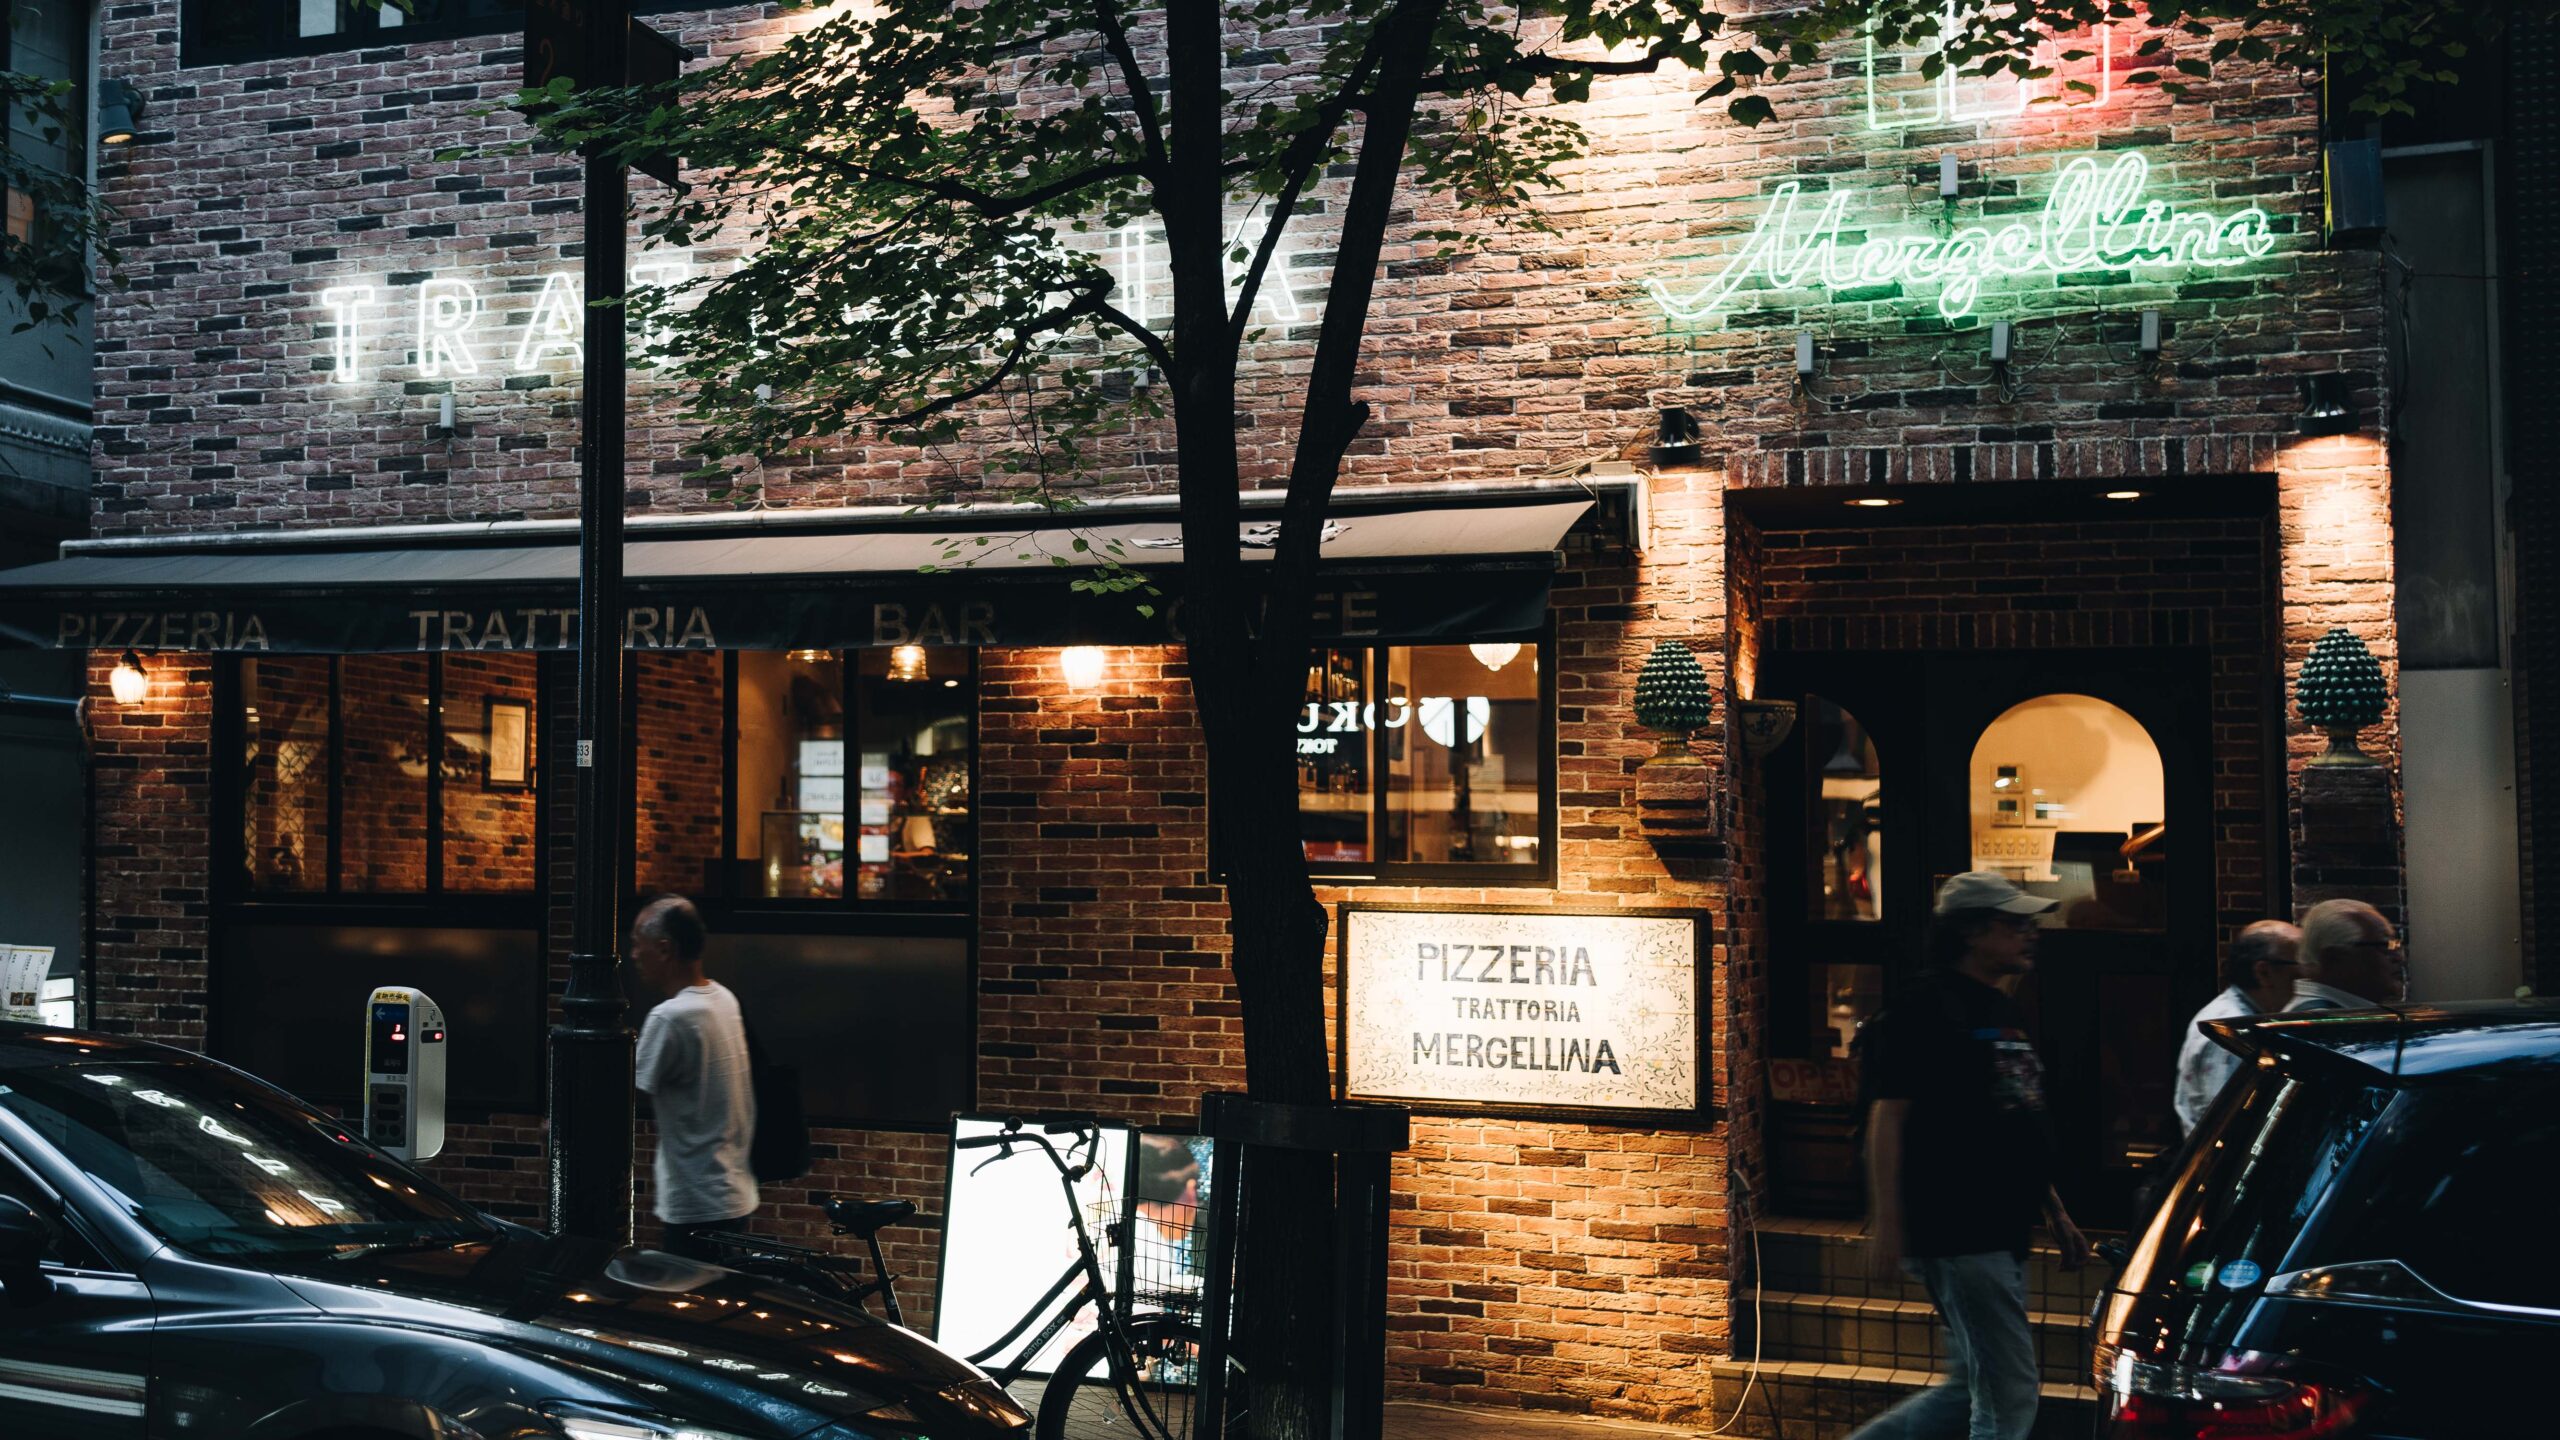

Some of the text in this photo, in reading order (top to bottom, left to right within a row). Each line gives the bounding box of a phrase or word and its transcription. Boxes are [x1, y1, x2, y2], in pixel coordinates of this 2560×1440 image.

[1642, 150, 2276, 321] Mergellina
[55, 610, 271, 651] PIZZERIA
[408, 605, 717, 651] TRATTRIA
[872, 600, 999, 646] BAR
[1417, 942, 1597, 987] PIZZERIA
[1452, 996, 1581, 1023] TRATTORIA
[1412, 1031, 1622, 1075] MERGELLINA
[1022, 1321, 1058, 1359] PATIO BOX
